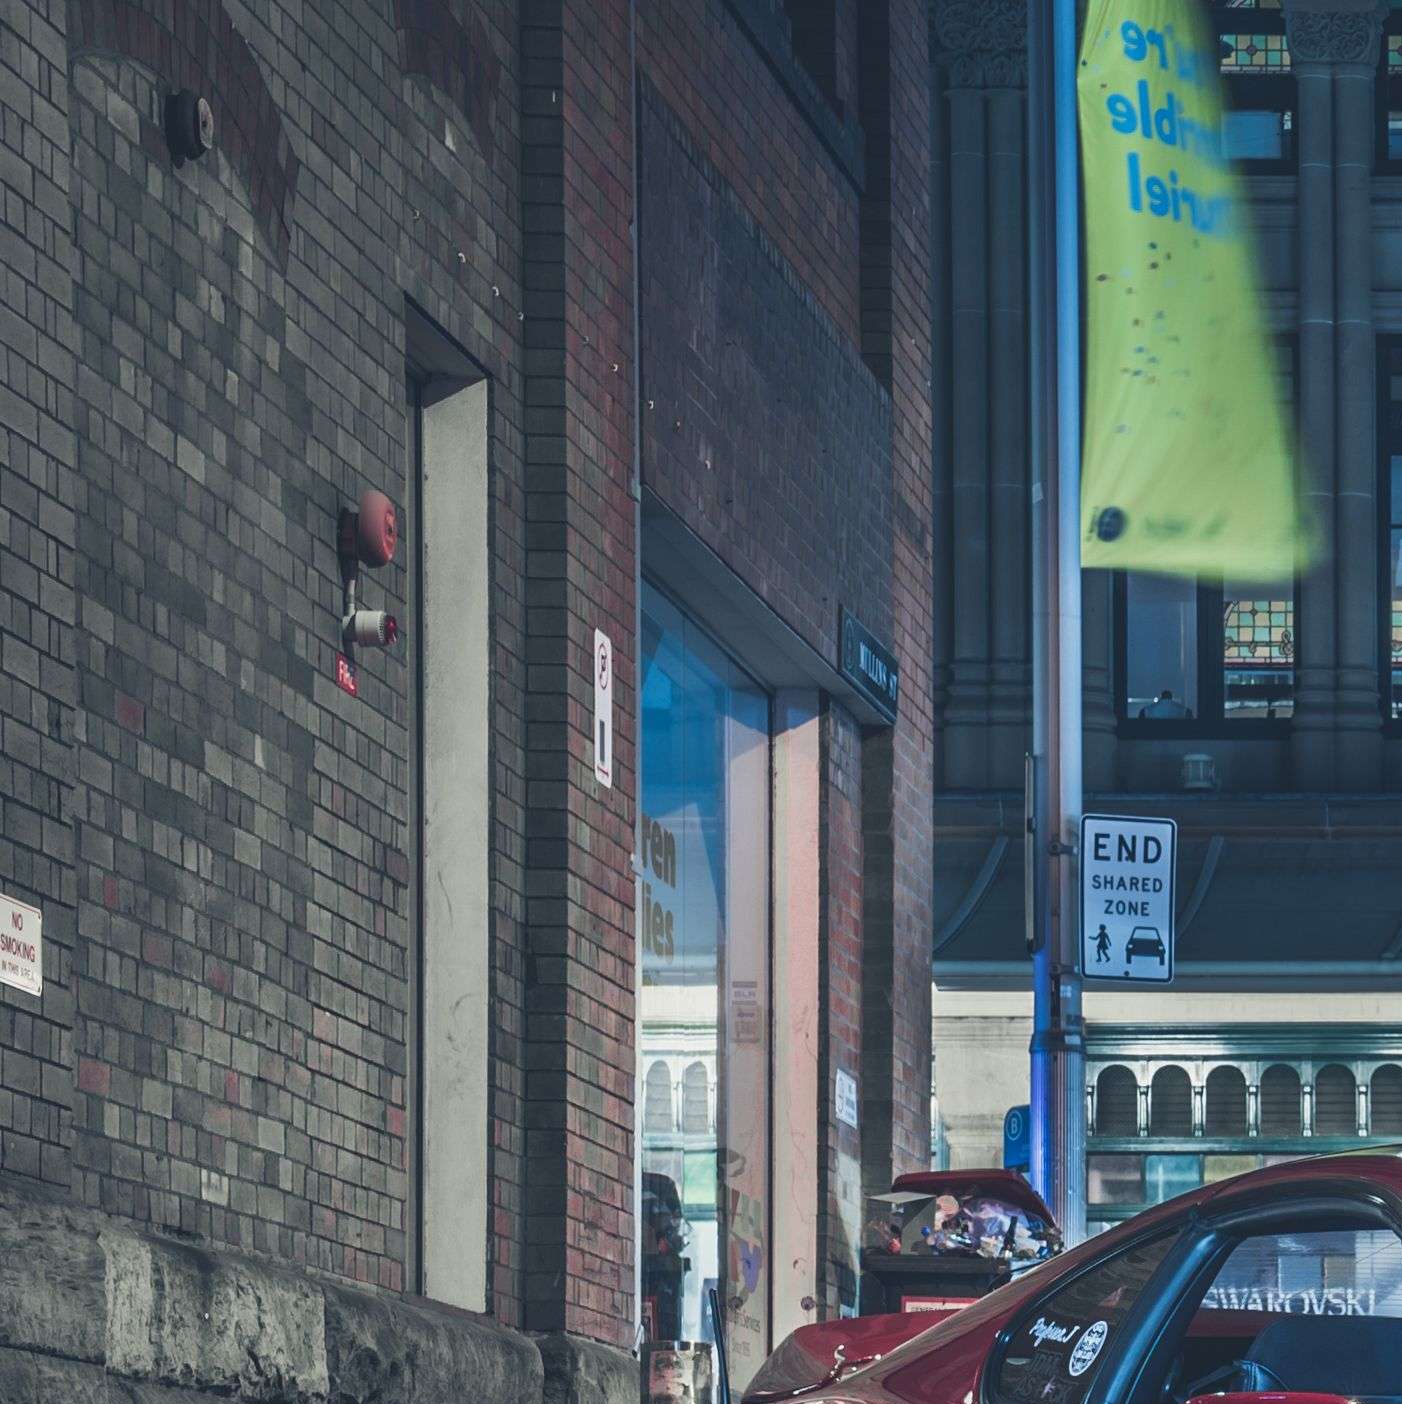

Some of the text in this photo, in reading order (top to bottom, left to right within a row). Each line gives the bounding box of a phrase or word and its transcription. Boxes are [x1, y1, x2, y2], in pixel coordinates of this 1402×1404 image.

[1094, 833, 1162, 863] END
[1092, 874, 1163, 893] SHARED
[1104, 900, 1150, 916] ZONE
[12, 911, 24, 931] NO
[0, 934, 36, 963] SMOKING
